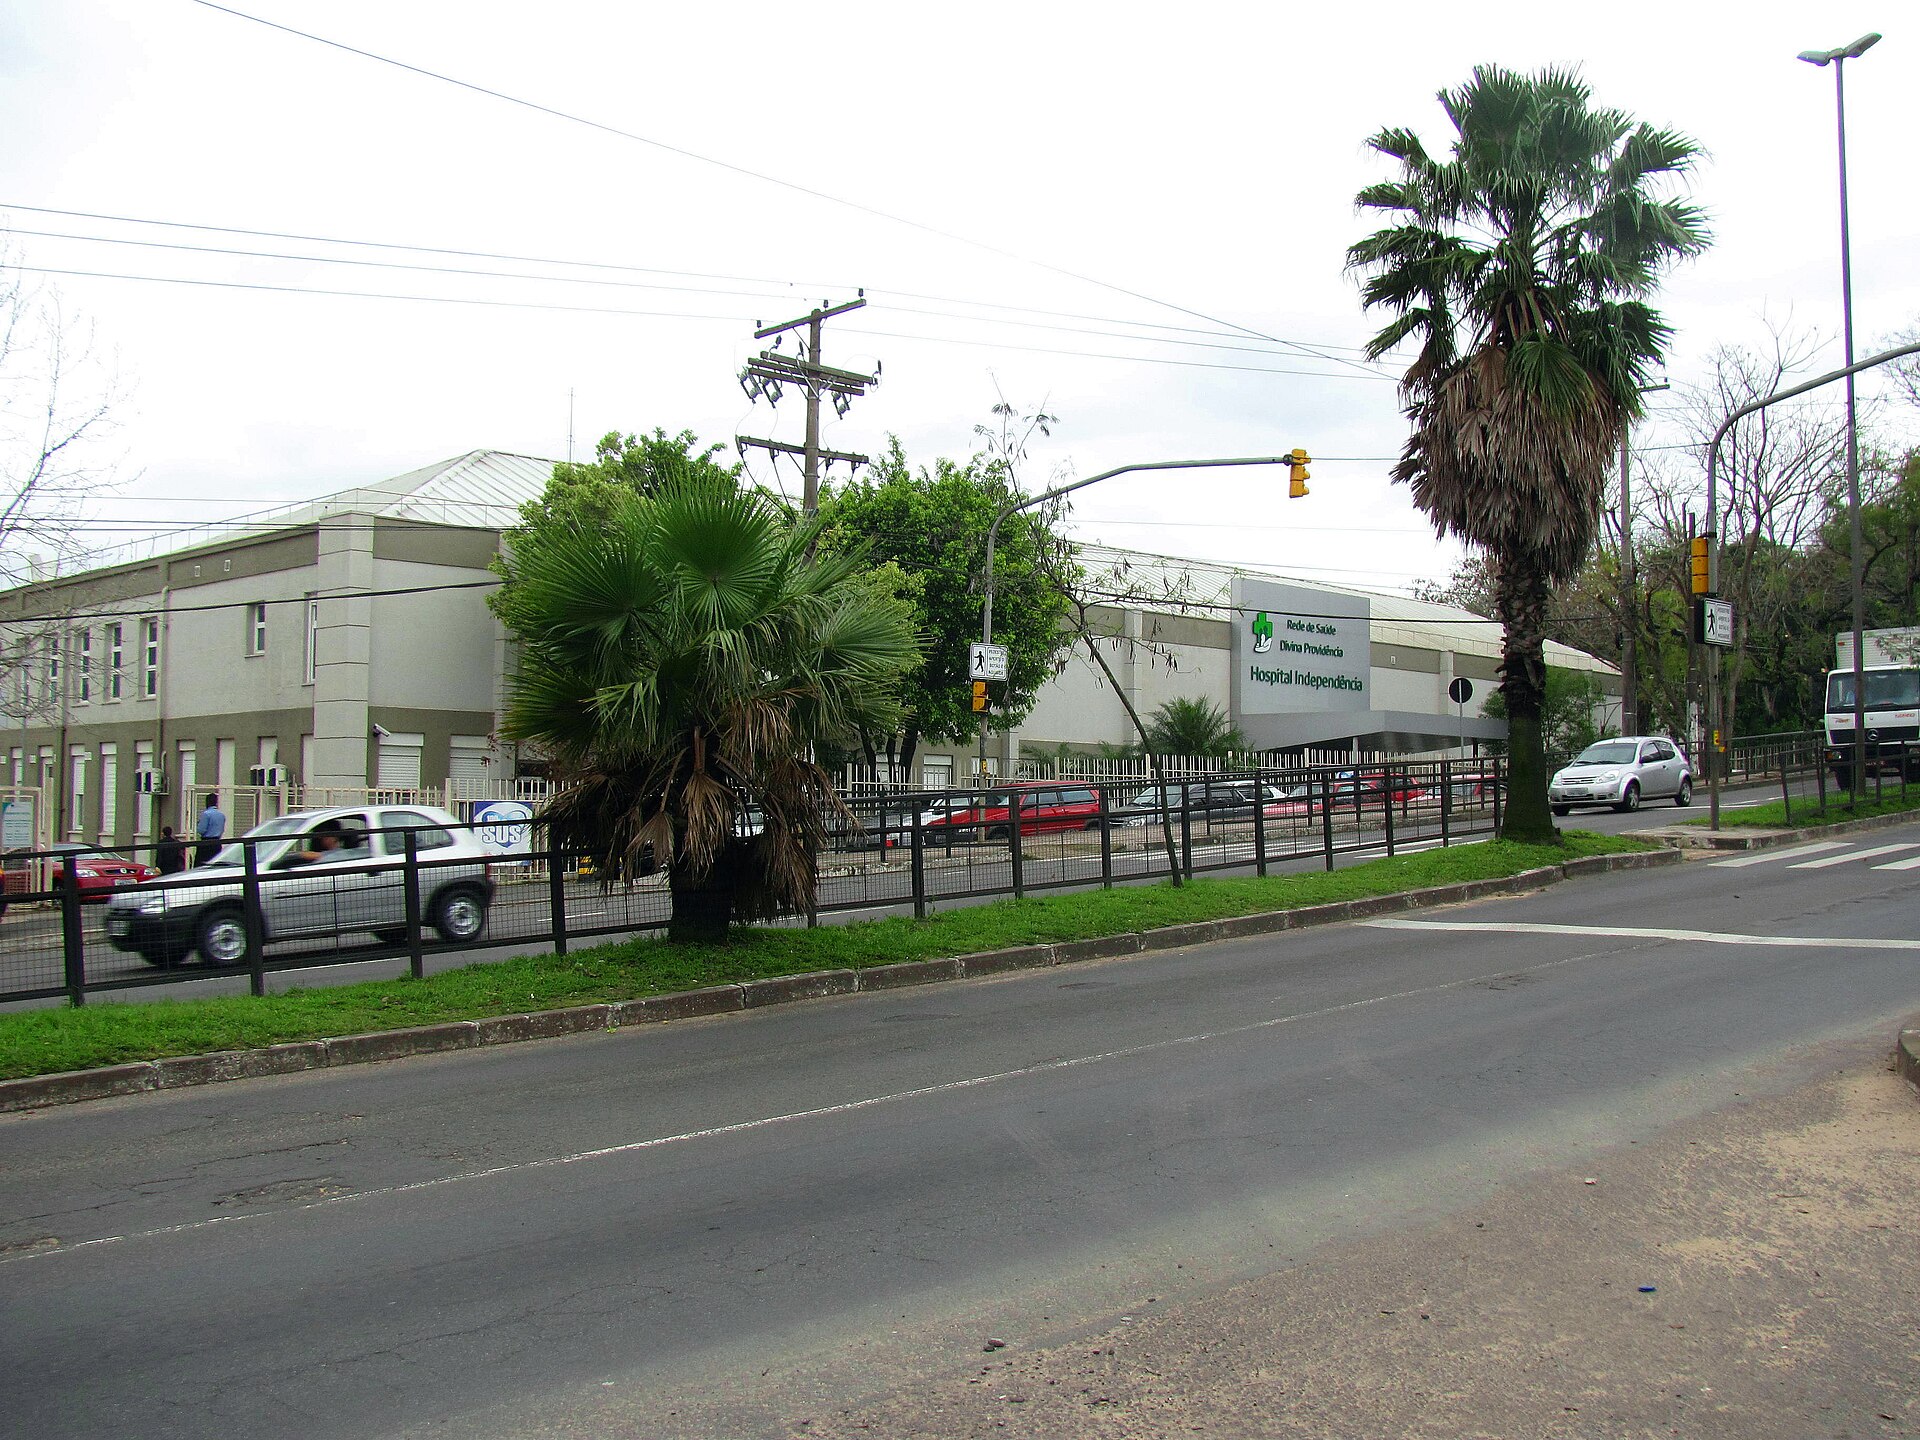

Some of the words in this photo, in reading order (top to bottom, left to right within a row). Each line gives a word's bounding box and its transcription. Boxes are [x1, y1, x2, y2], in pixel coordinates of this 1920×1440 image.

[1286, 619, 1305, 632] Rede
[1306, 622, 1315, 633] de
[1316, 623, 1337, 636] Saúde
[1280, 640, 1303, 653] Divina
[1303, 643, 1344, 658] Providência
[1250, 665, 1293, 686] Hospital
[1294, 670, 1363, 692] Independência
[481, 824, 521, 844] SUS
